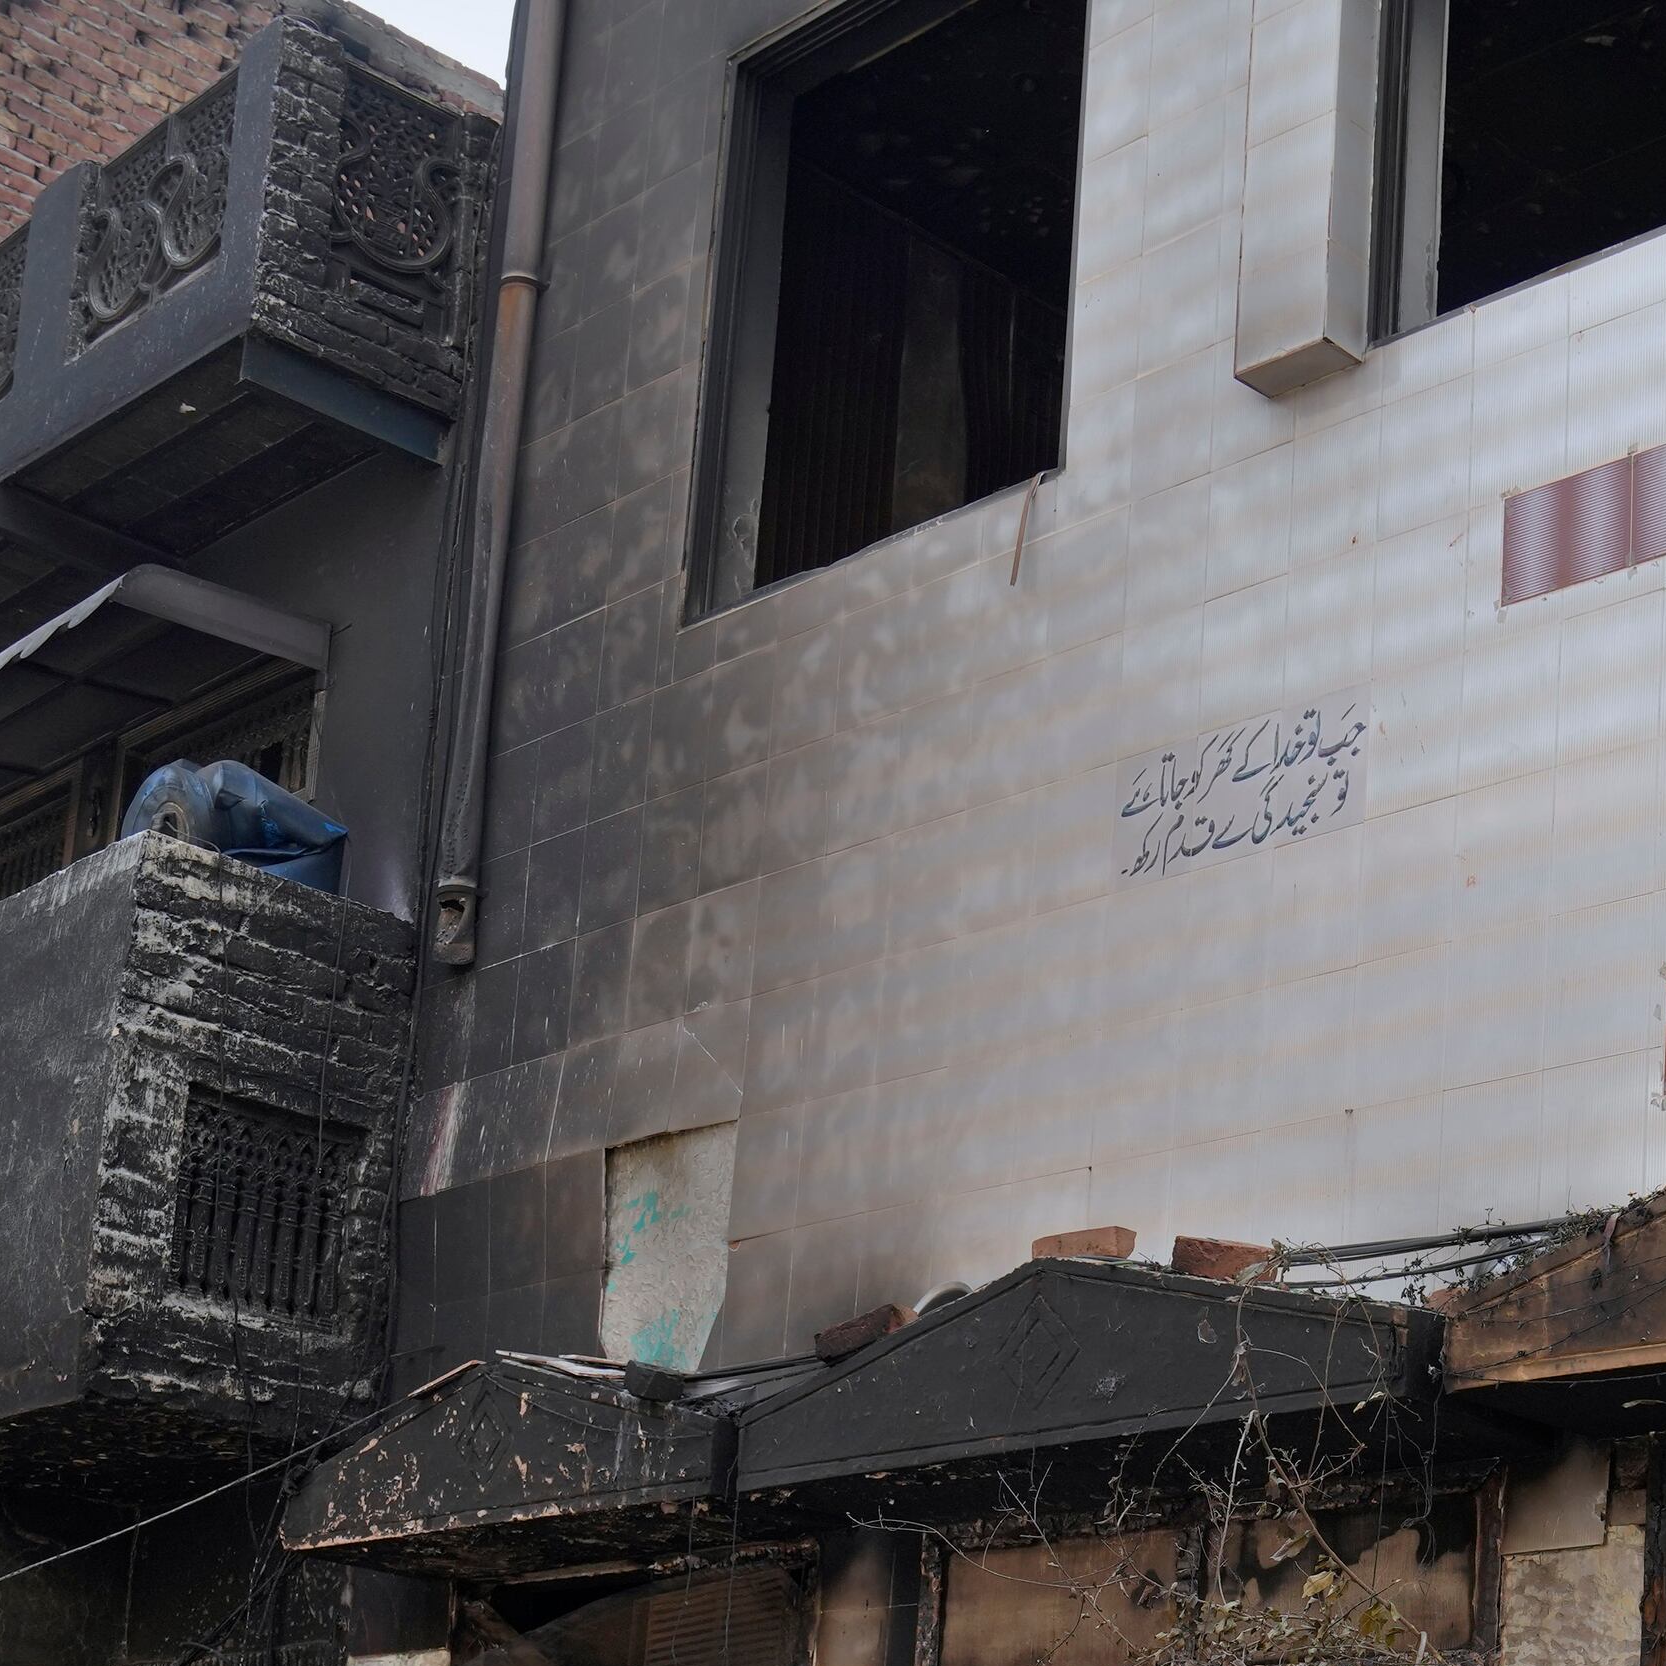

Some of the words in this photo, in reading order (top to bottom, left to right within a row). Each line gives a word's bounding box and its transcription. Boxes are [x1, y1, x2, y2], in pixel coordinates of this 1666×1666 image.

[1232, 720, 1271, 782] کے
[1270, 723, 1305, 774] خدا
[1298, 709, 1321, 765] تو
[1160, 752, 1188, 810] جاتا
[1182, 734, 1219, 799] کو
[1330, 769, 1349, 817] تو
[1163, 814, 1215, 876] قدم
[1212, 815, 1252, 849] سے
